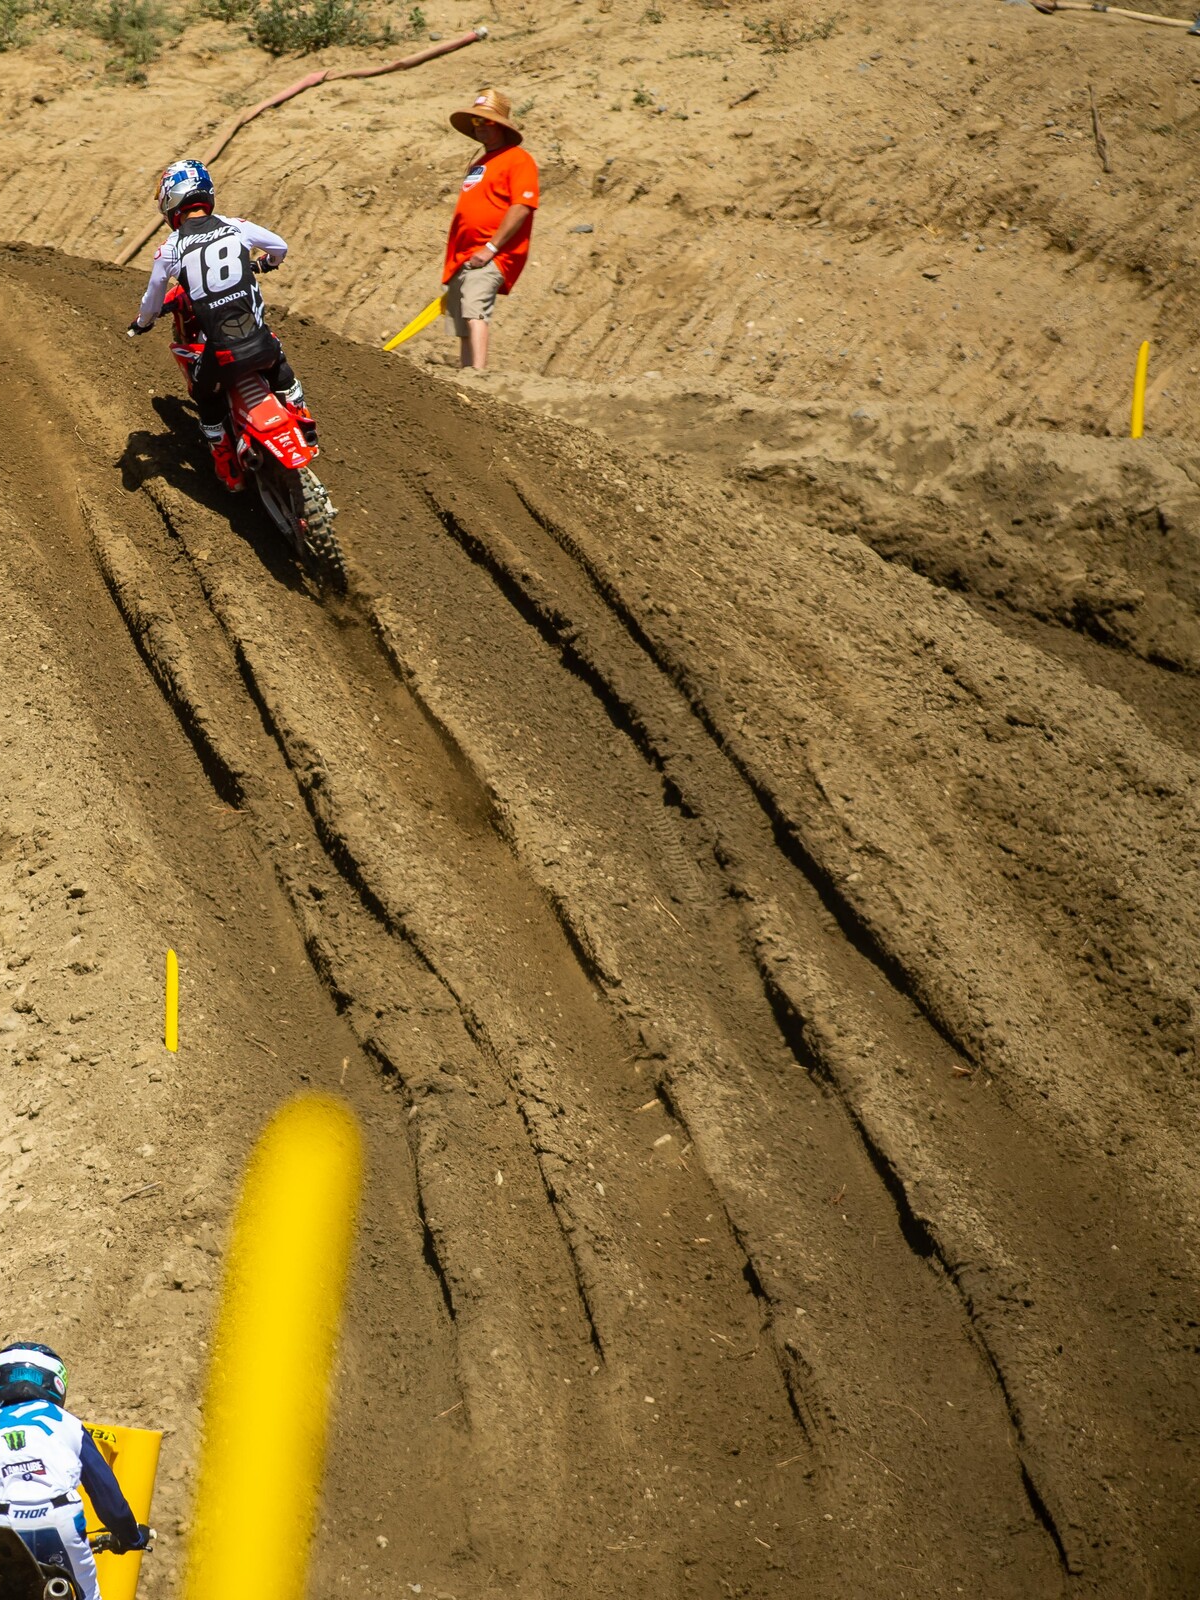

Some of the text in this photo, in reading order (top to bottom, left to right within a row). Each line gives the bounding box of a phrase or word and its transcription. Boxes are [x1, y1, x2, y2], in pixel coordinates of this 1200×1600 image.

[181, 235, 243, 300] 18
[208, 290, 248, 309] HONDA
[13, 1507, 49, 1519] THOR
